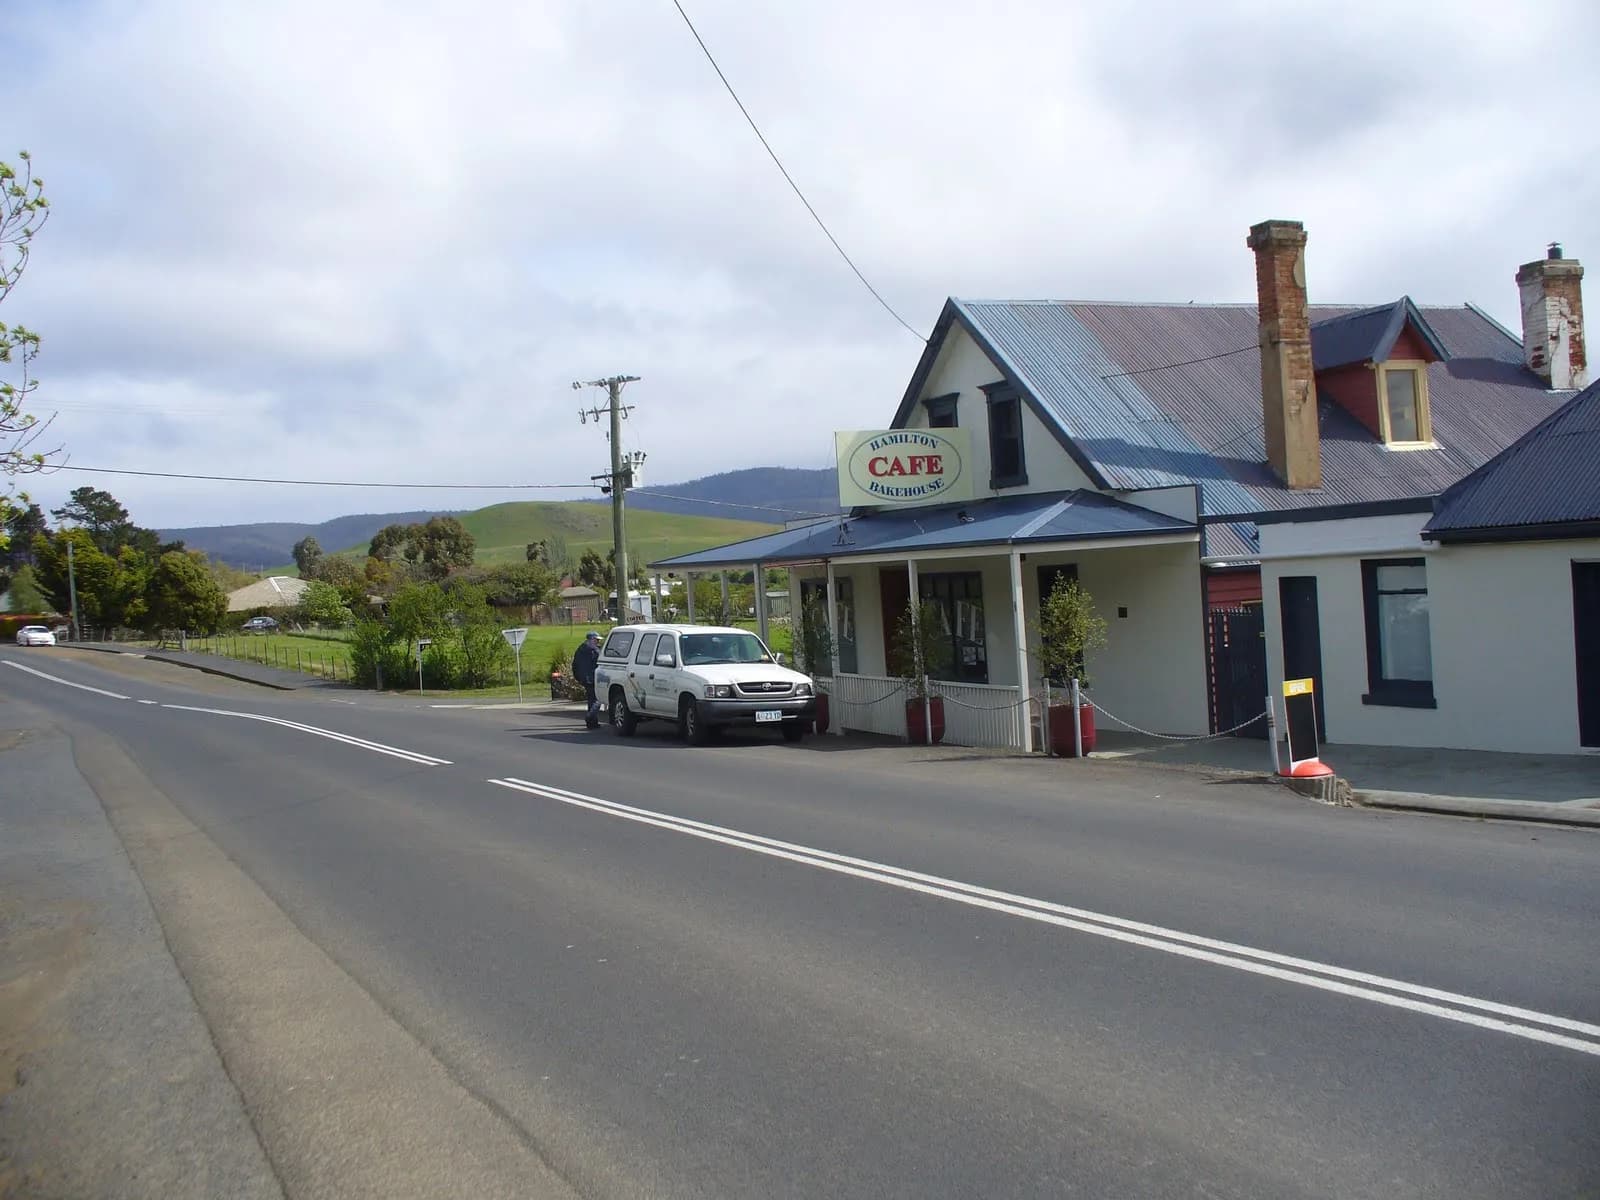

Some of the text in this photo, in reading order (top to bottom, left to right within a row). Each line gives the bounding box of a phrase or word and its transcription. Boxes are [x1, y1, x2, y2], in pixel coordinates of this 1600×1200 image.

[870, 434, 938, 451] HAMILTON
[868, 455, 943, 477] CAFE
[869, 478, 944, 497] BAKEHOUSE
